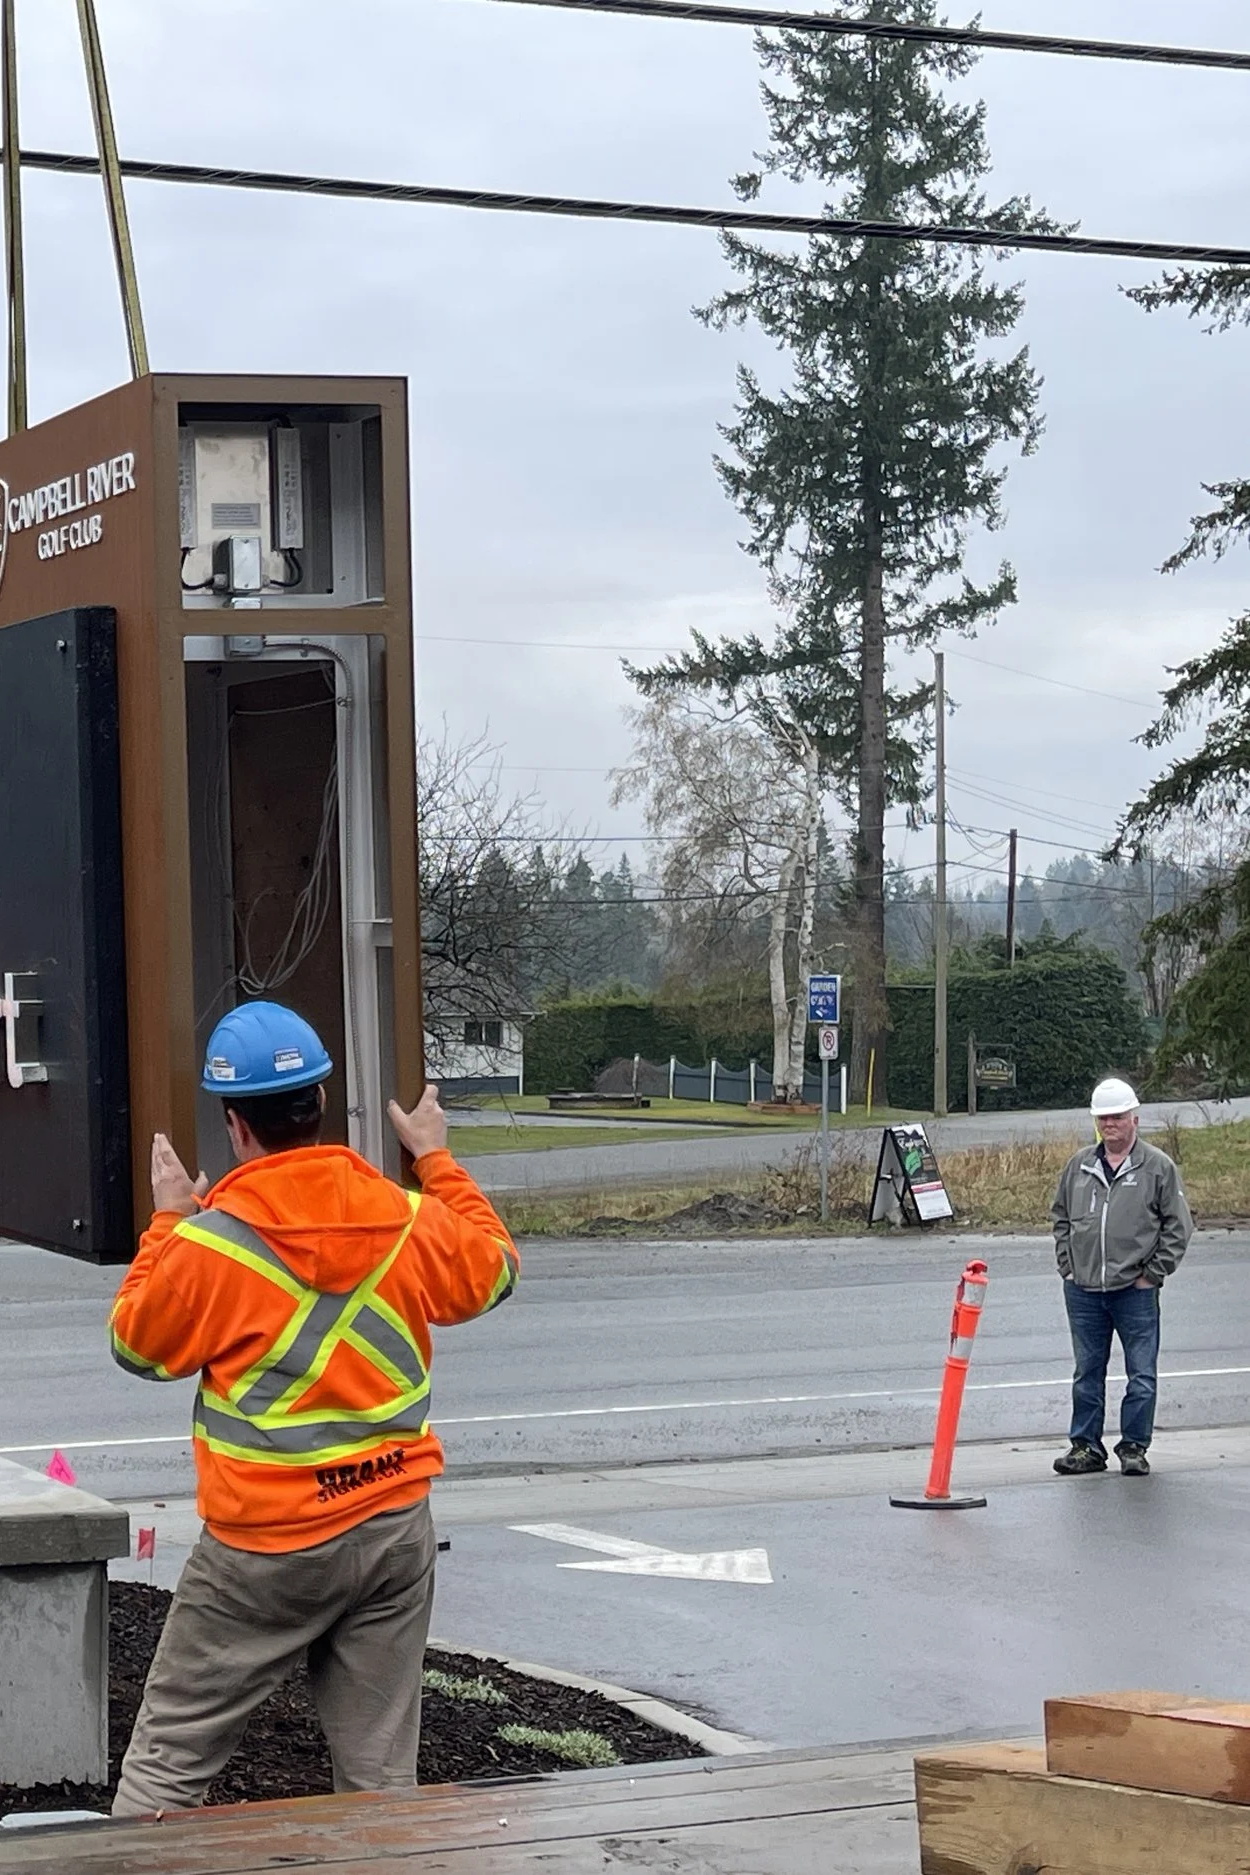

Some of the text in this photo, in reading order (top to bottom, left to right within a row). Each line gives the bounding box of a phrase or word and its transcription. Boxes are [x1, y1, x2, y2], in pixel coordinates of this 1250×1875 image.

[8, 473, 87, 533] CAMPBELL
[87, 452, 136, 505] RIVER
[38, 514, 102, 560] GOLF CLUB
